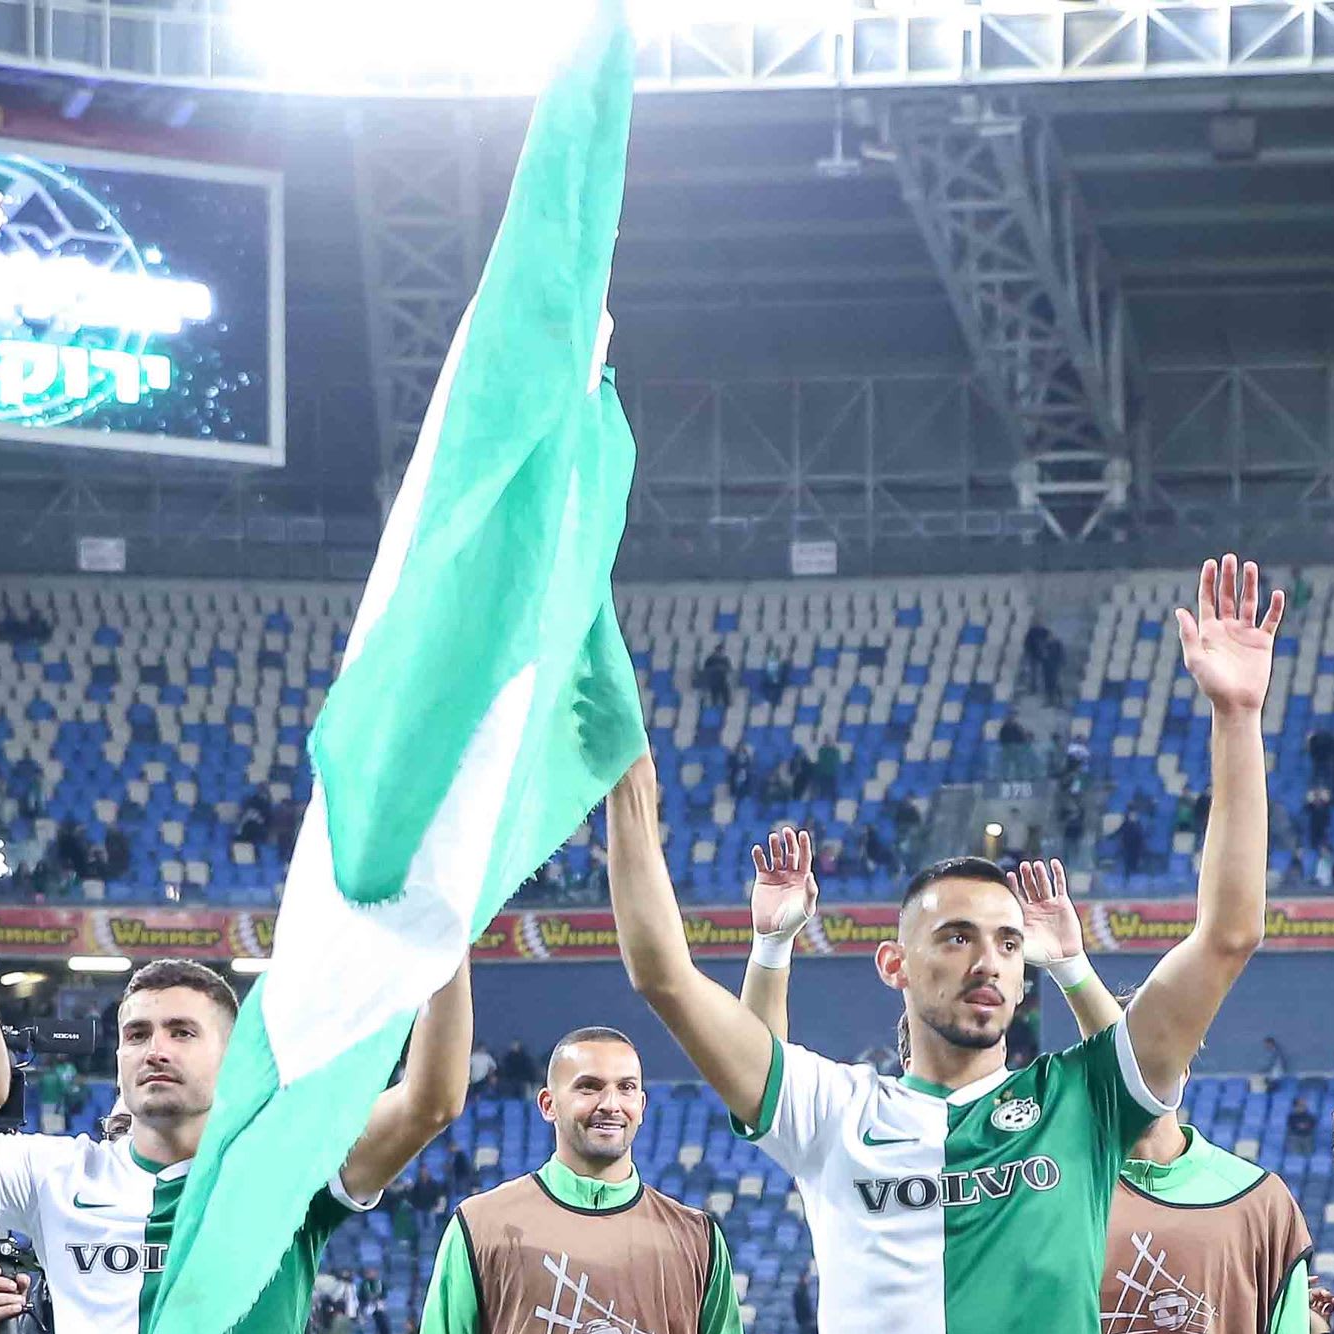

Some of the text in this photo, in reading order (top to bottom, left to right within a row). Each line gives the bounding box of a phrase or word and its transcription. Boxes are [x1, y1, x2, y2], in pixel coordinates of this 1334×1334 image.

[110, 917, 221, 947] Winner
[853, 1154, 1060, 1214] VOLVO
[66, 1243, 167, 1275] VOL
